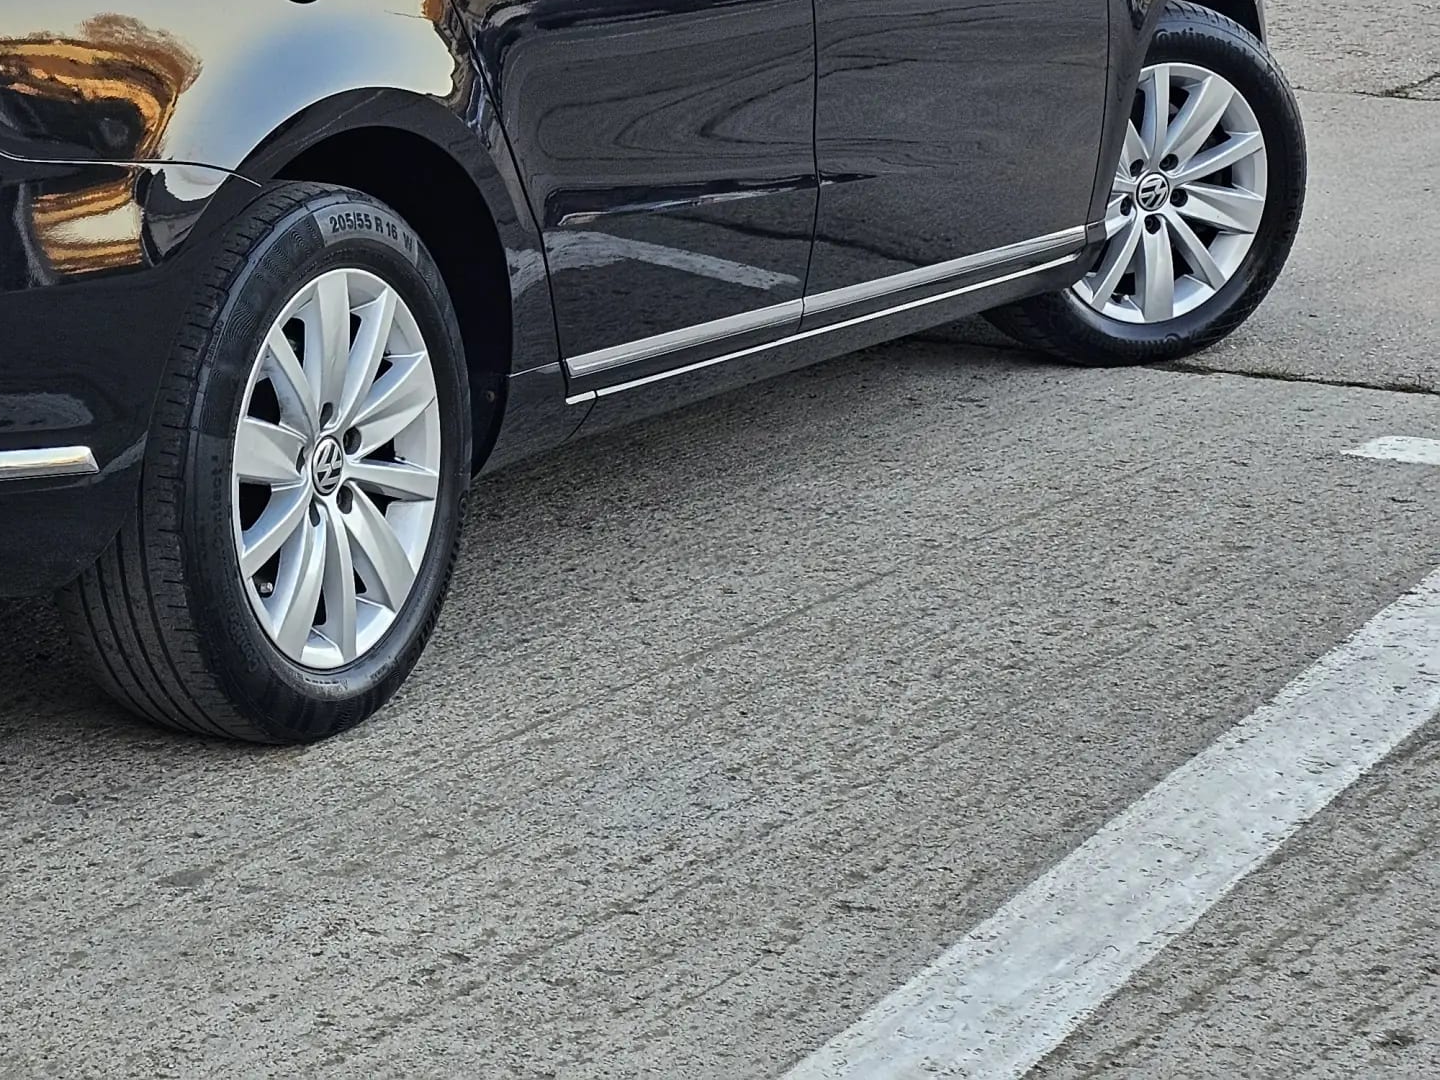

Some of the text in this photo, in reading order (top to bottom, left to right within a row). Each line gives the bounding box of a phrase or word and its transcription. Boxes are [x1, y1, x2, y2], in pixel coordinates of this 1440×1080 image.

[329, 211, 372, 234] 205/55
[375, 216, 384, 234] R
[386, 221, 399, 241] 16
